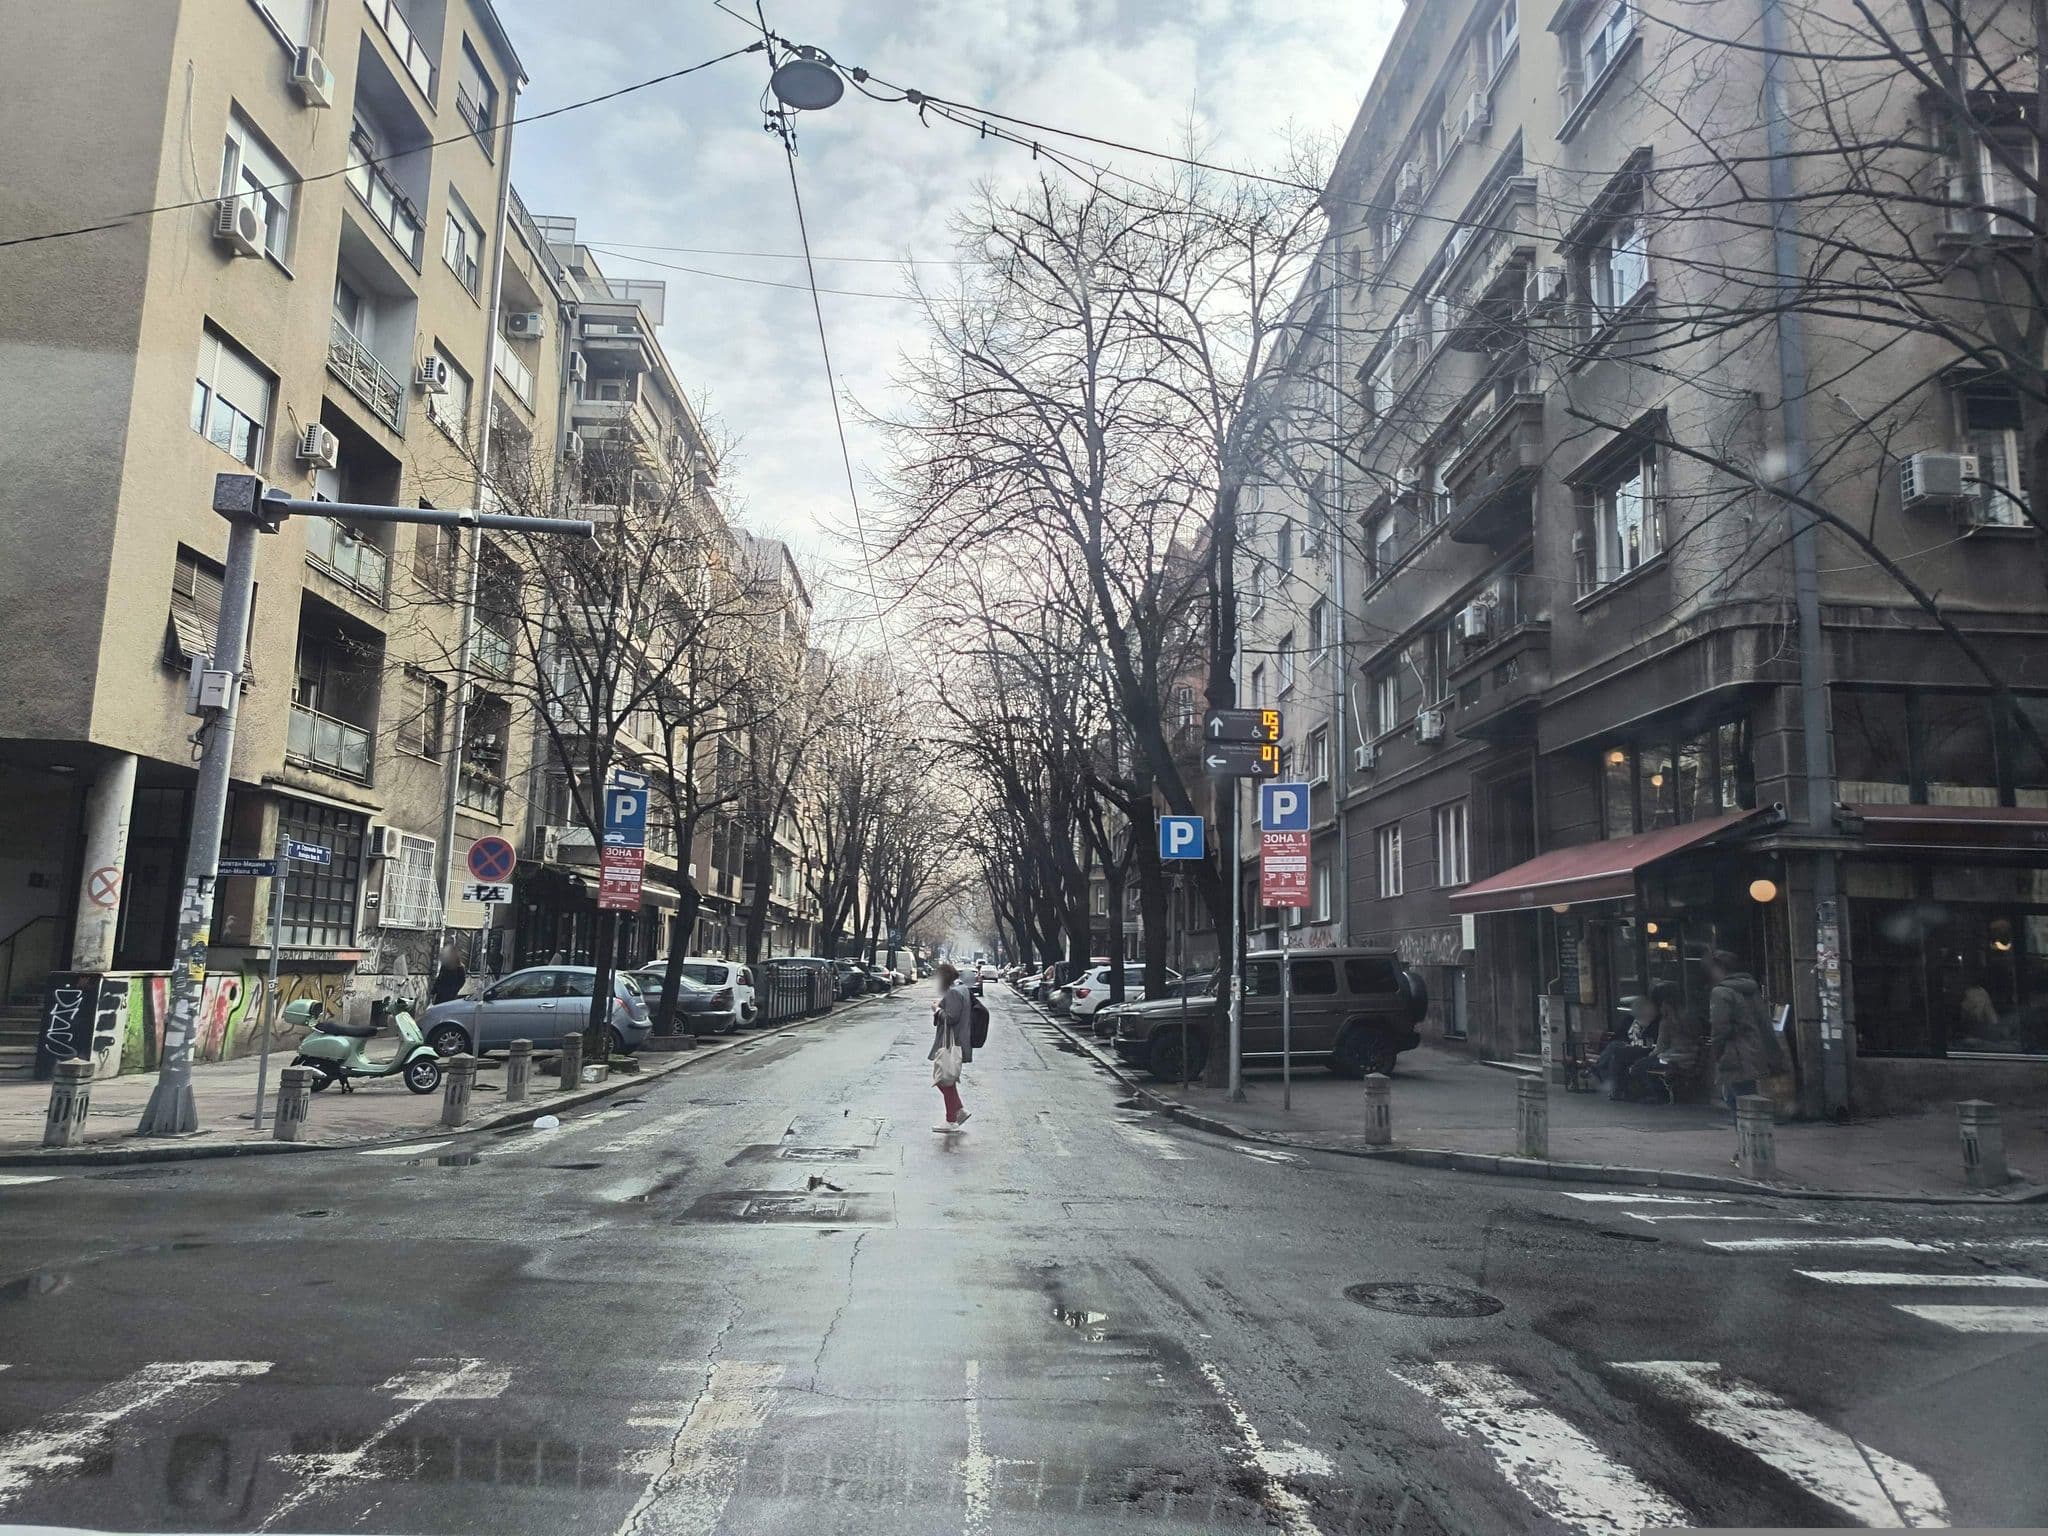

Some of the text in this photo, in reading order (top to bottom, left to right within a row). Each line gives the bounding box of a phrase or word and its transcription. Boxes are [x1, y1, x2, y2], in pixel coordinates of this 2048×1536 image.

[1262, 711, 1279, 726] 05
[1269, 726, 1279, 740] 2
[1262, 745, 1279, 761] 01
[615, 795, 637, 823] P
[1273, 791, 1298, 825] P
[1170, 822, 1194, 854] P
[1263, 834, 1306, 843] ЗОНА 1
[605, 847, 642, 858] ЗОНА 1
